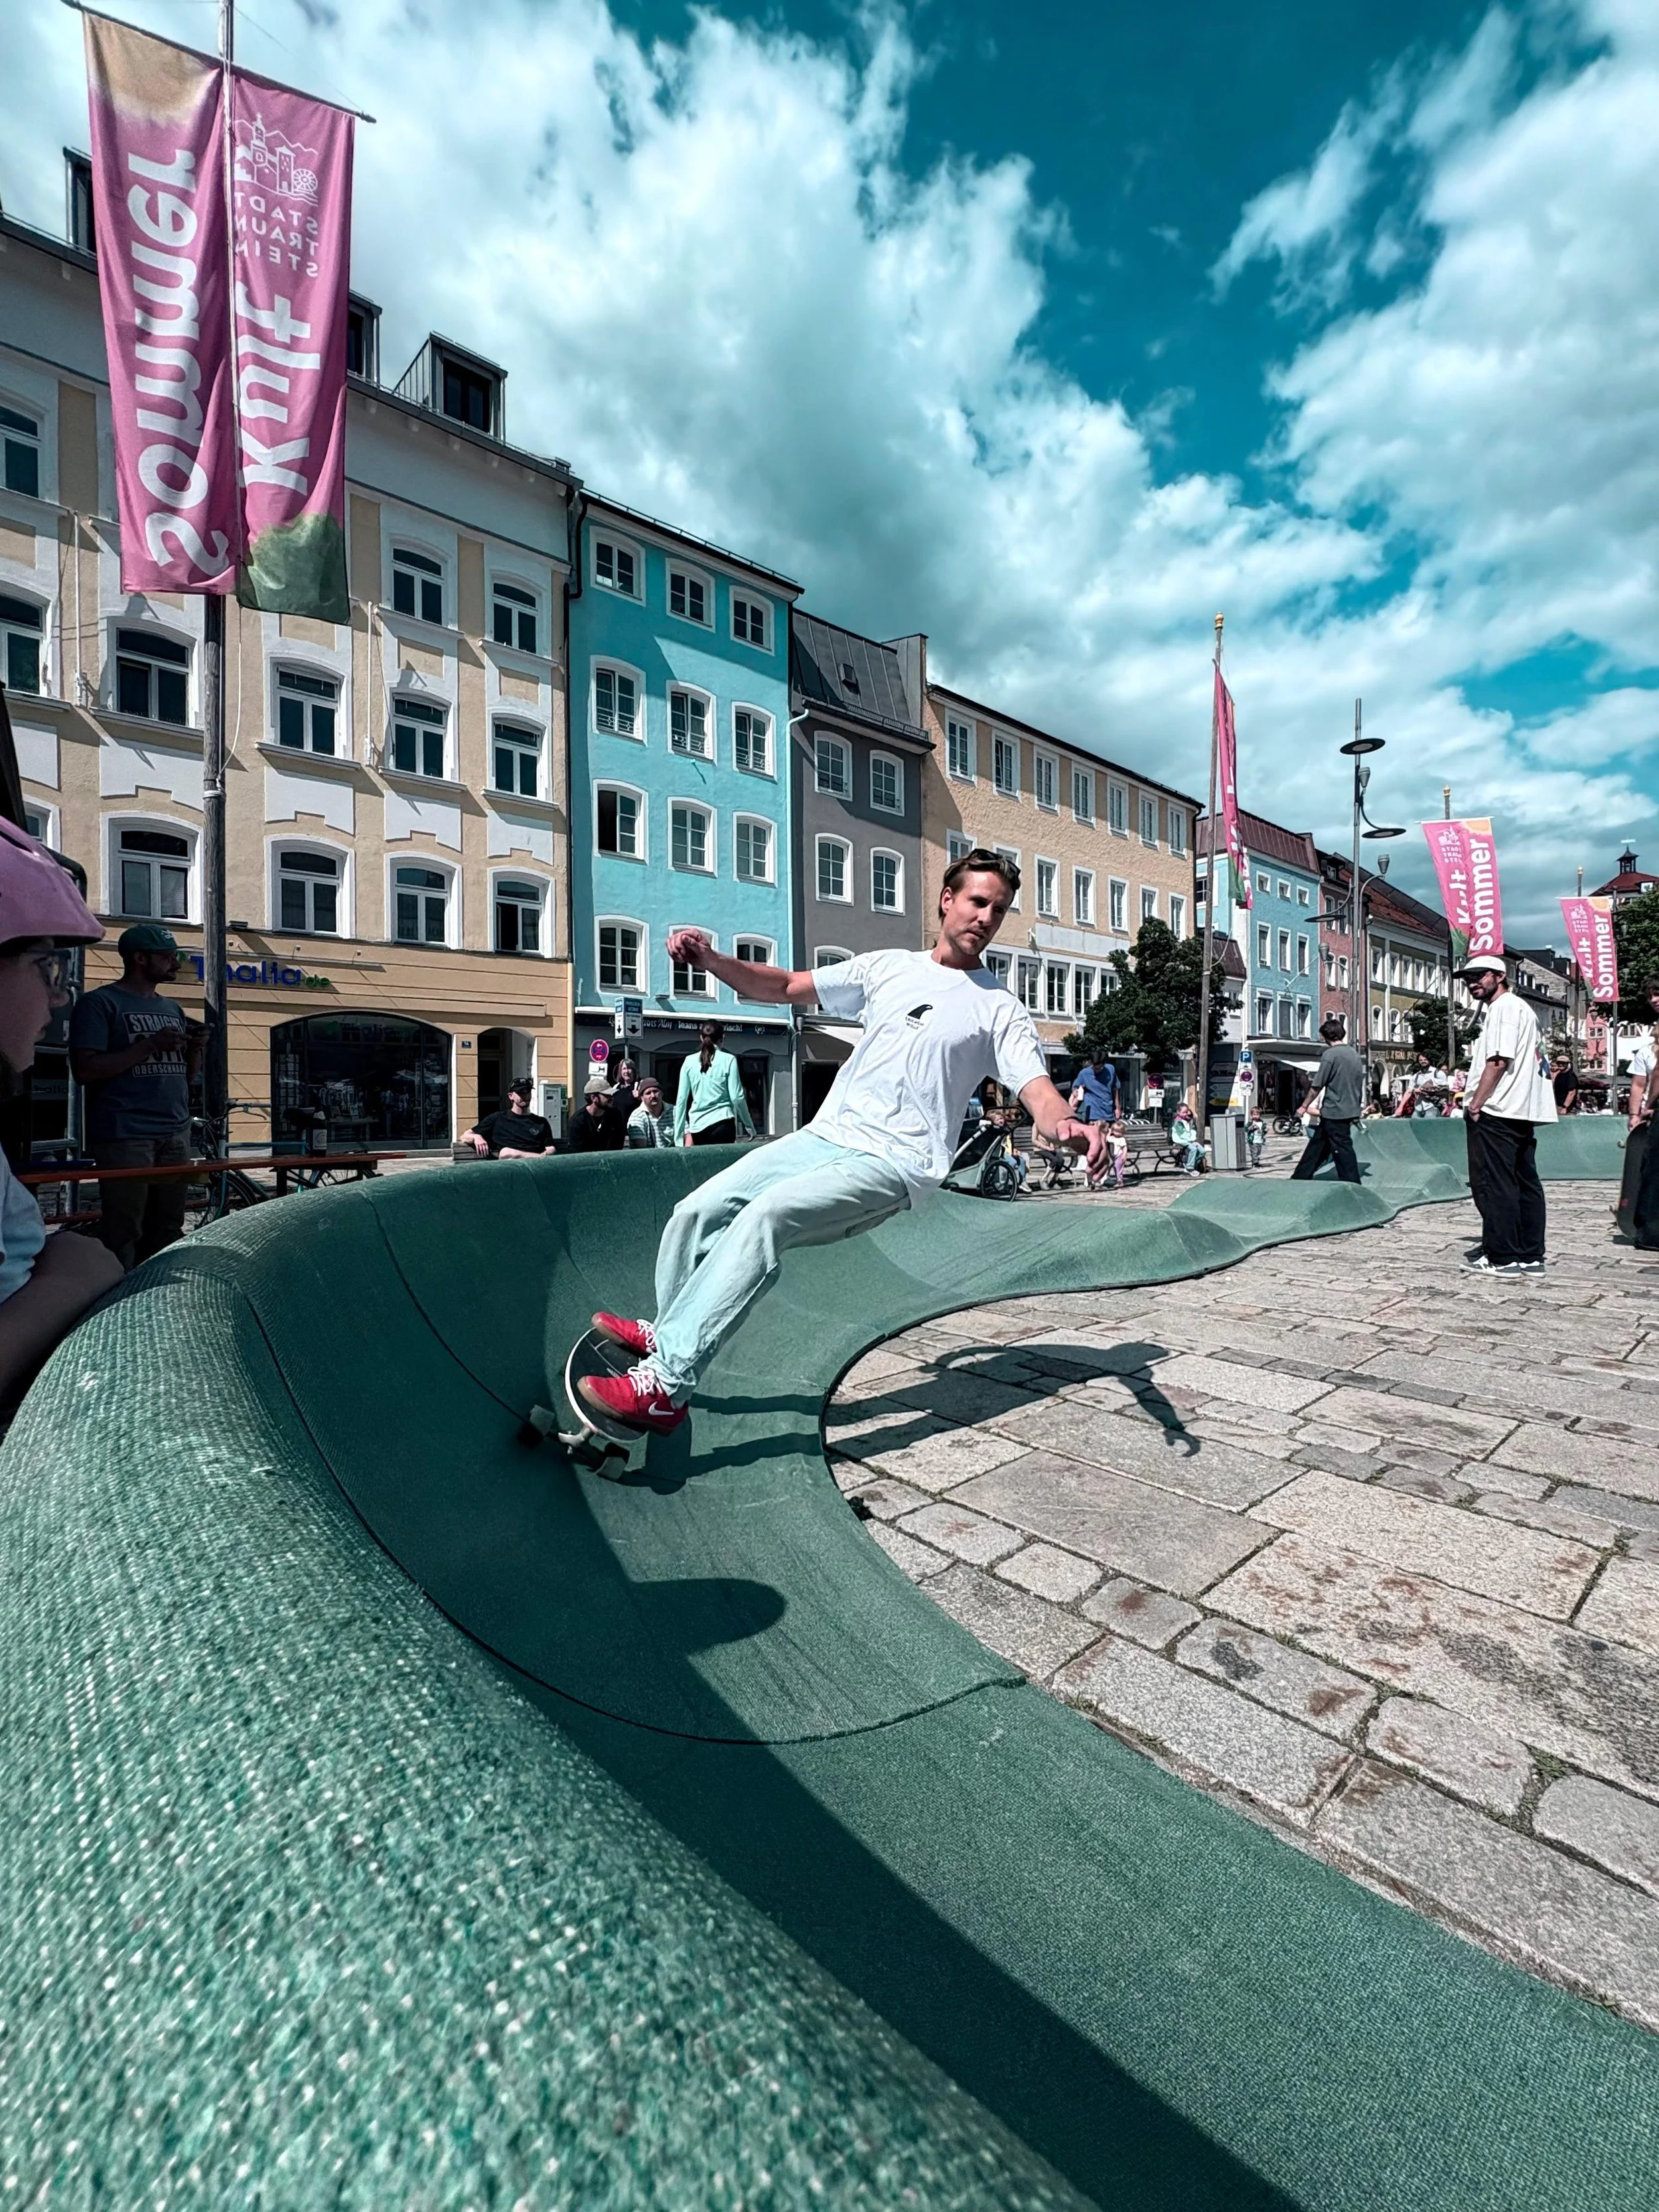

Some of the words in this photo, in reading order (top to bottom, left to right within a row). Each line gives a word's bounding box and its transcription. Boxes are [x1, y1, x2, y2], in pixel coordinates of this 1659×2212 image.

[1469, 838, 1494, 951] Sommer
[1593, 914, 1614, 998] Sommer
[1242, 1052, 1249, 1061] P
